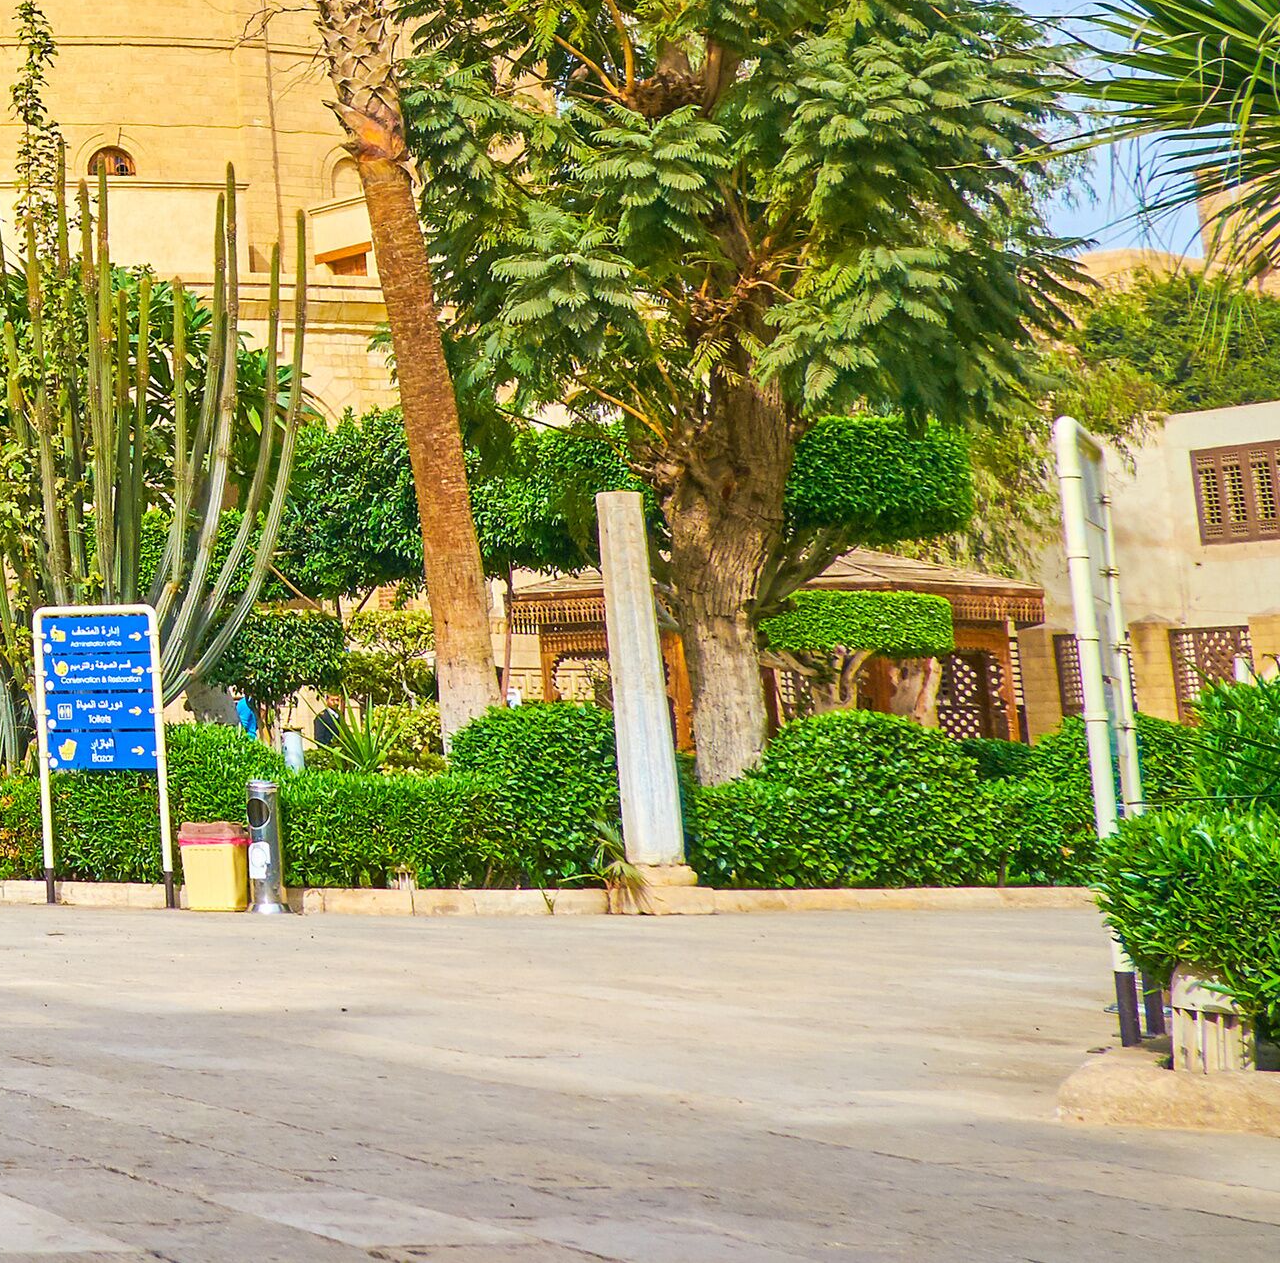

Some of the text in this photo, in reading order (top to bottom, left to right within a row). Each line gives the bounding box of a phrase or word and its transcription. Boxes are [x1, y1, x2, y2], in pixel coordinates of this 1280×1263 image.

[71, 625, 100, 636] المتحف
[60, 675, 142, 684] Conservation & Restoration
